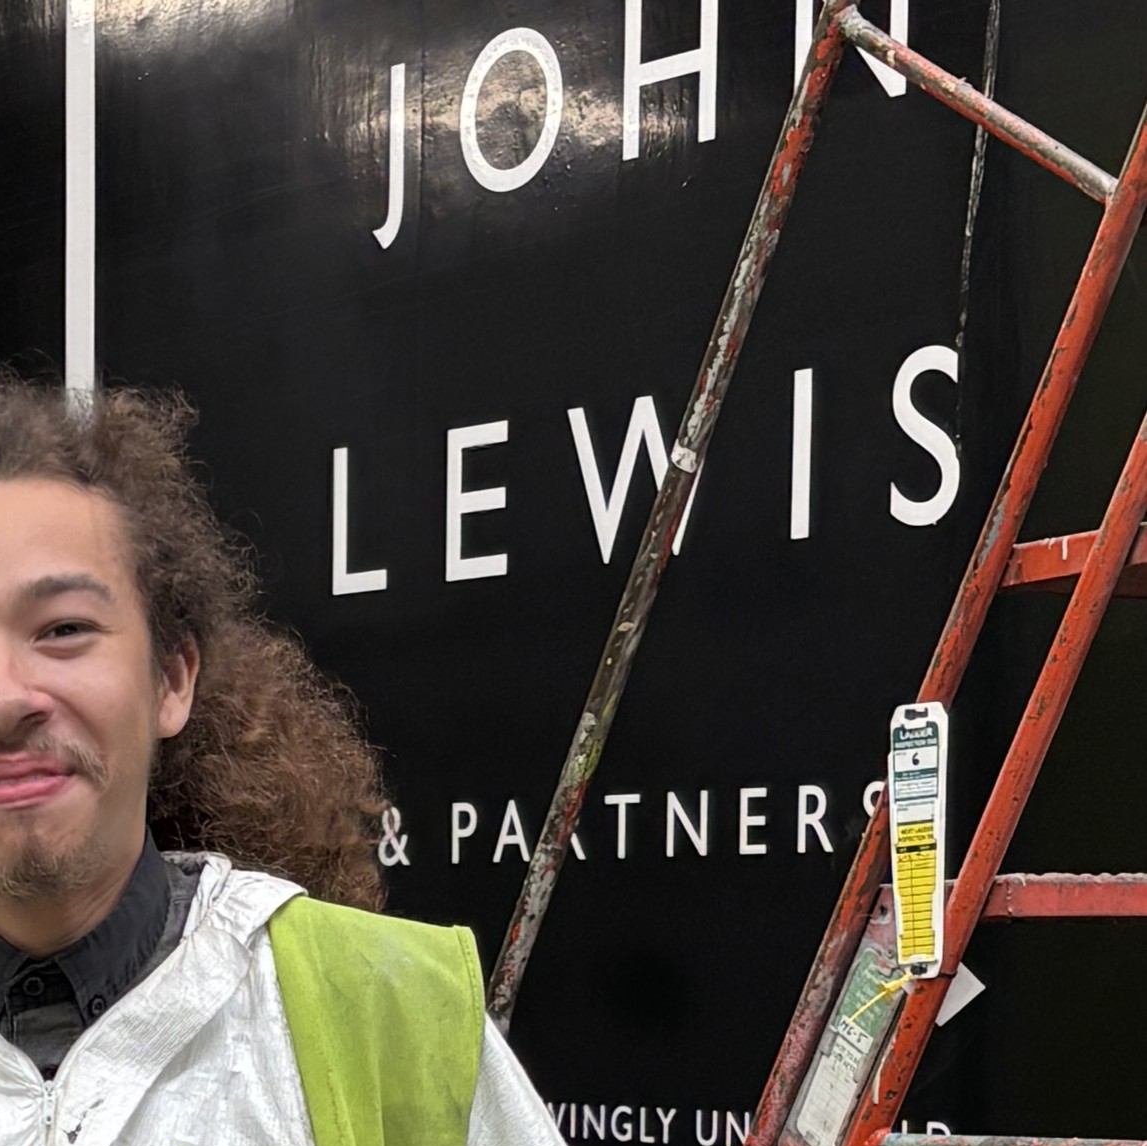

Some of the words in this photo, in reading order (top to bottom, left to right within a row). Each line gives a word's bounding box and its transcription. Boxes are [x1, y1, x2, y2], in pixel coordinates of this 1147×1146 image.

[331, 344, 962, 596] LEWIS
[911, 752, 920, 766] 6
[378, 805, 411, 867] &
[451, 780, 886, 866] PATNER
